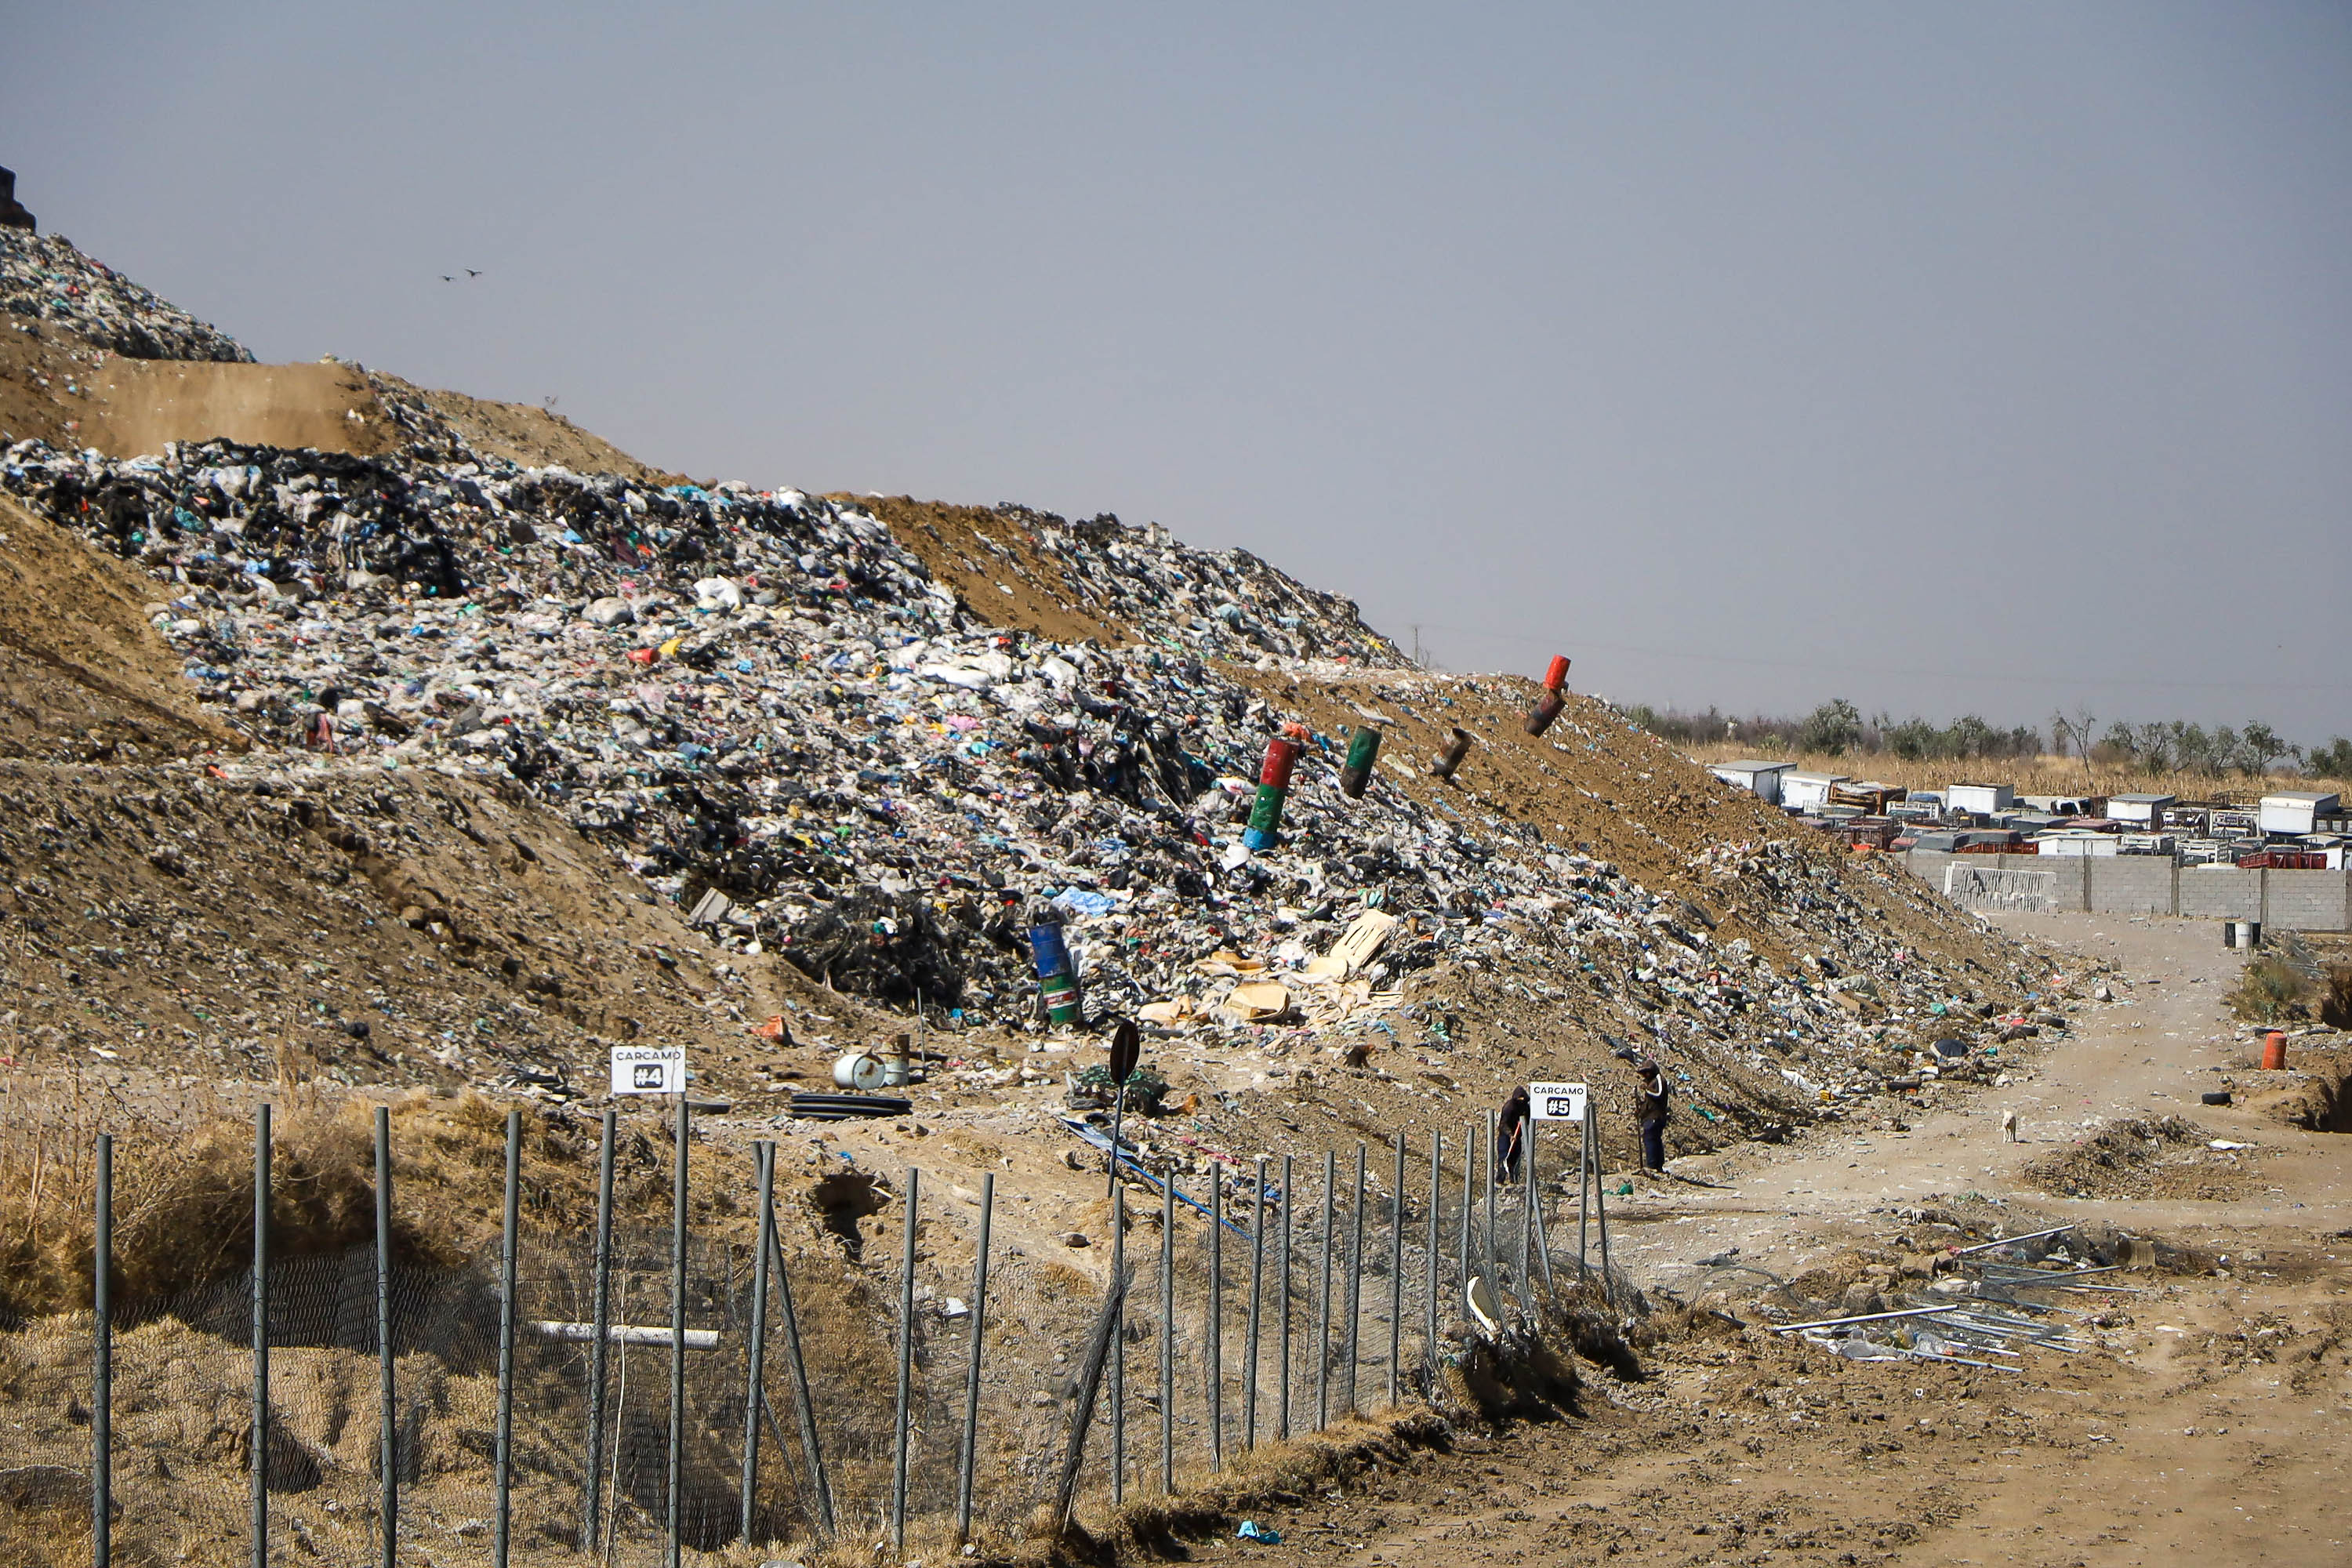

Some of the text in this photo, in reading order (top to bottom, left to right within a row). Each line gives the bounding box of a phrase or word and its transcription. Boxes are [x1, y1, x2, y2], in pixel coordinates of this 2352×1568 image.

[616, 1051, 681, 1060] CARCAMO
[635, 1067, 662, 1086] #4
[1548, 1099, 1569, 1114] #5
